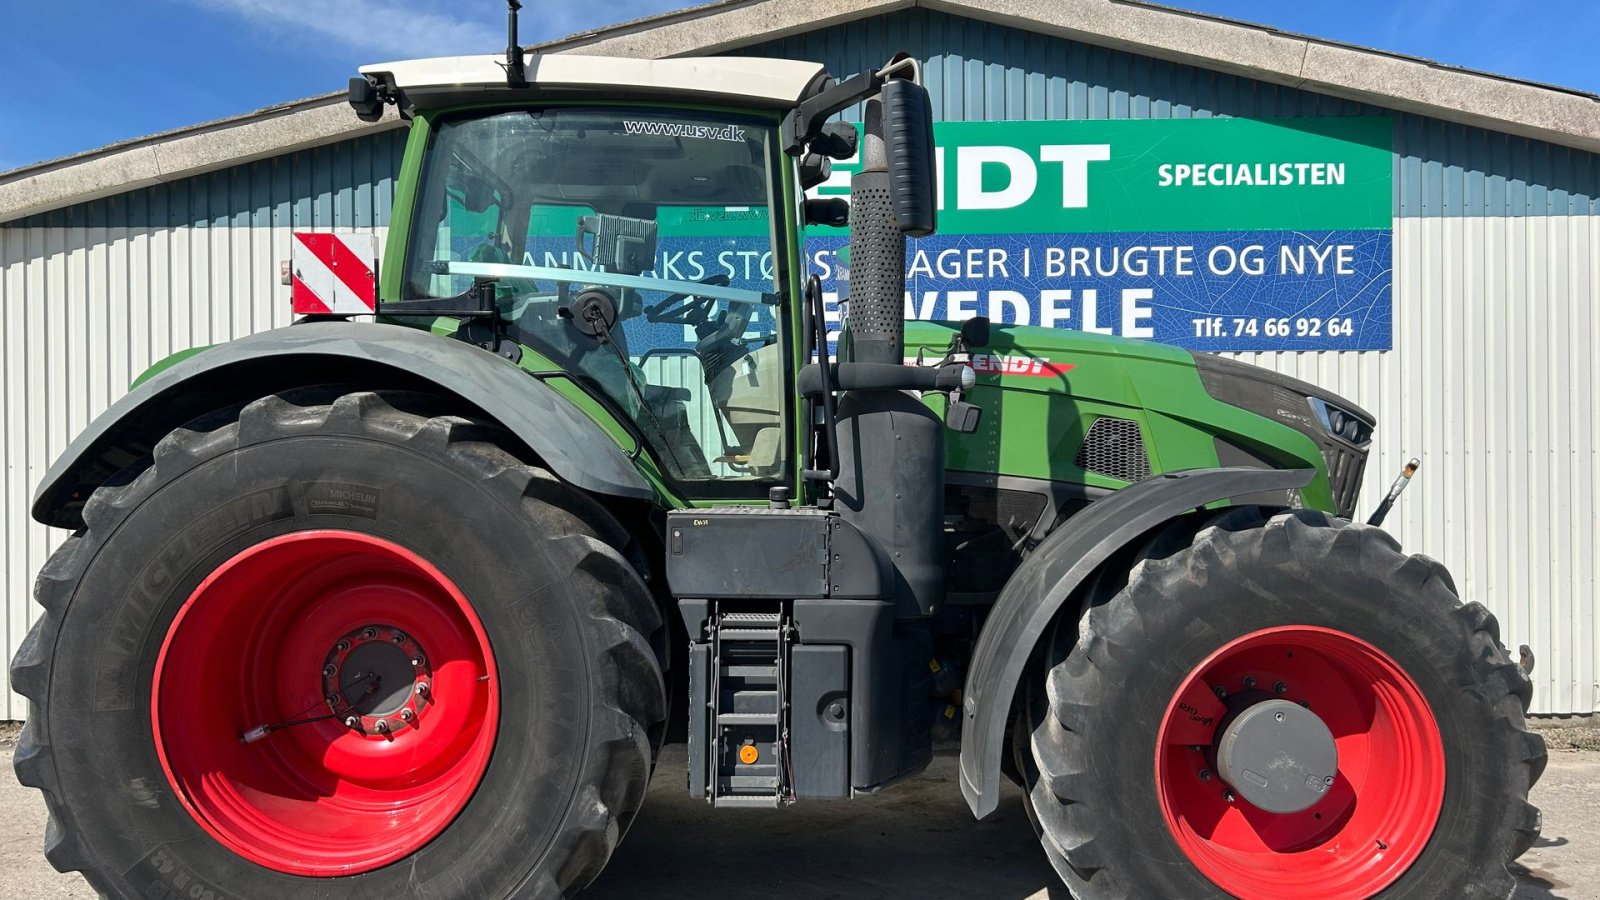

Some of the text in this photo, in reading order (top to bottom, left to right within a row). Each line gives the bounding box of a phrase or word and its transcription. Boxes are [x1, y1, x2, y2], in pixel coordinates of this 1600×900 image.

[623, 120, 745, 142] www.usv.dk
[1157, 162, 1346, 187] SPECIALISTEN
[903, 248, 1010, 280] AGER
[1023, 247, 1031, 278] I
[1045, 246, 1195, 278] BRUGTE
[1207, 245, 1265, 277] OG
[1280, 244, 1355, 276] NYE
[1191, 316, 1355, 338] Tlf. 74 66 92 64
[971, 353, 1051, 375] ENDT
[329, 489, 377, 504] MICHELIN
[152, 850, 176, 874] 42
